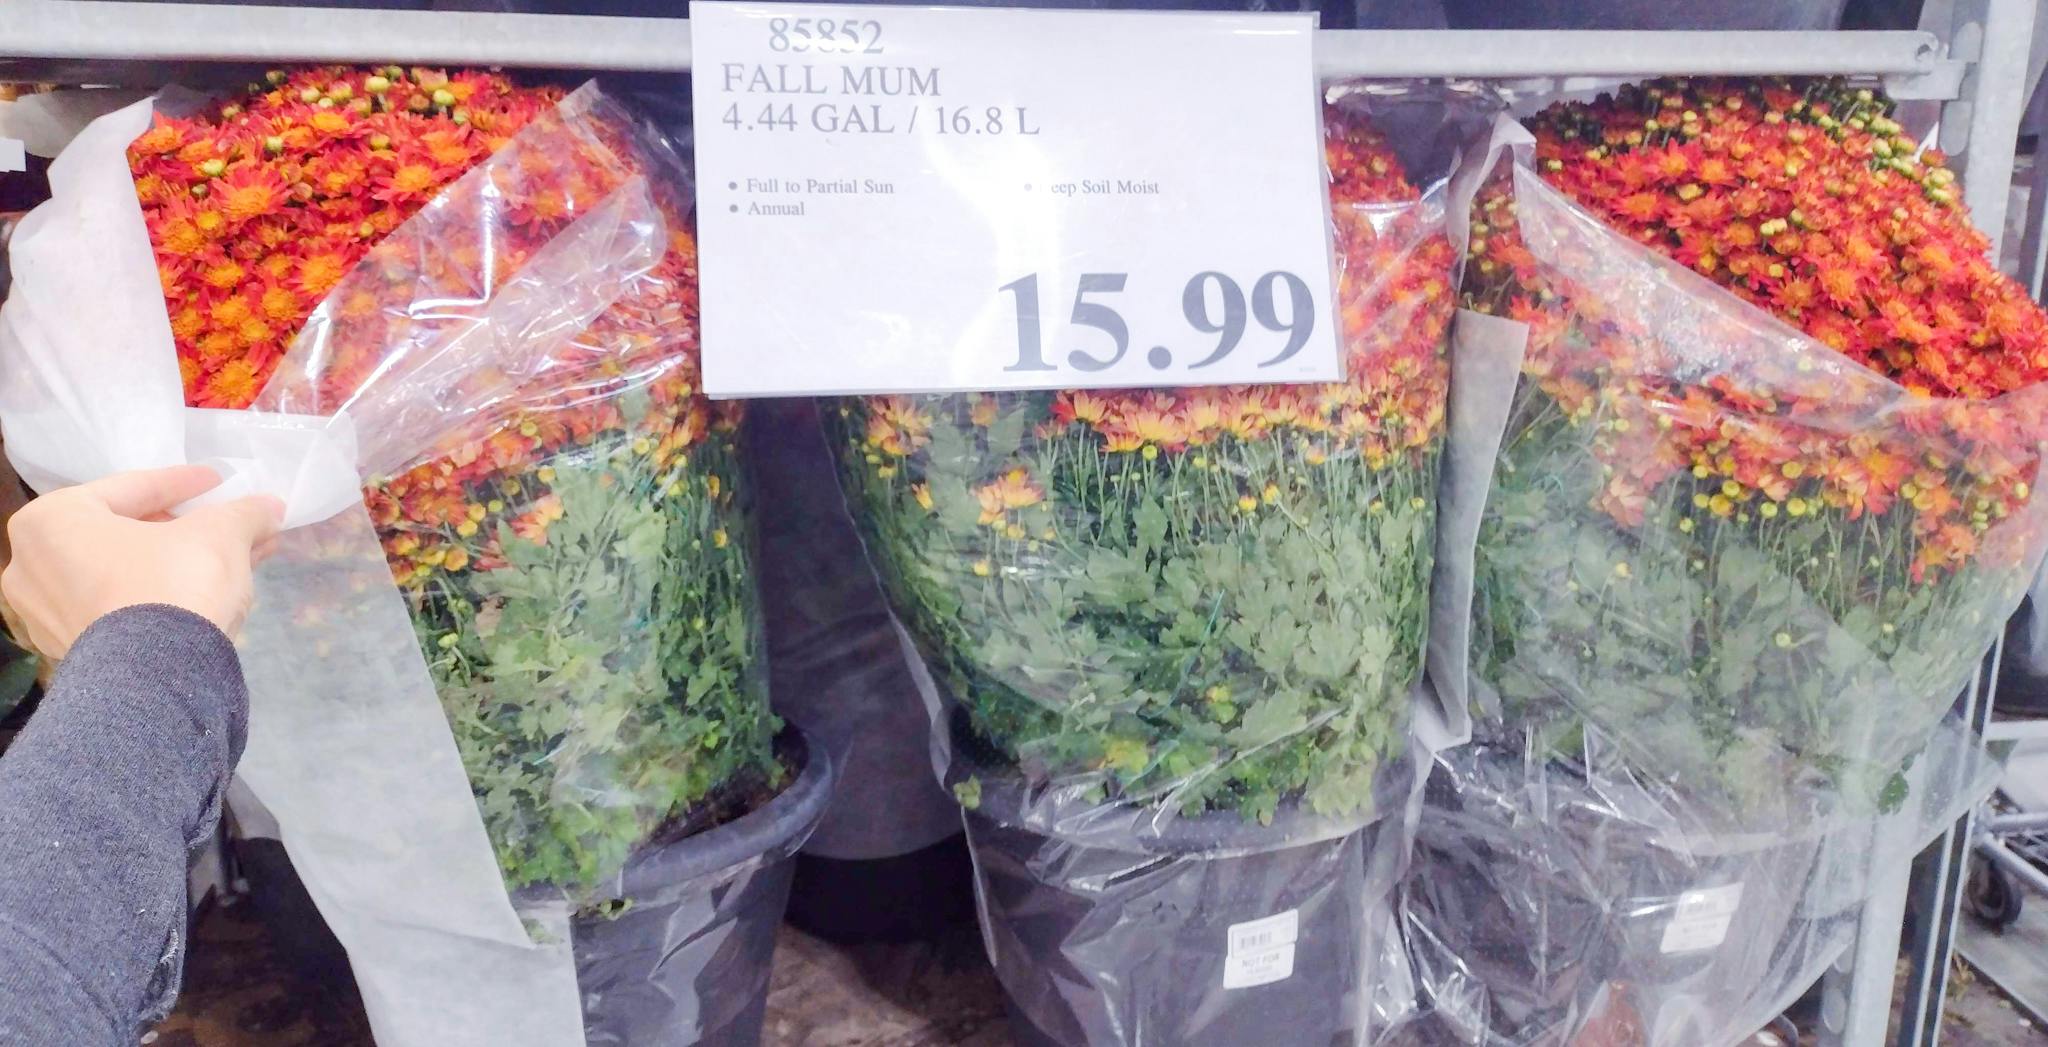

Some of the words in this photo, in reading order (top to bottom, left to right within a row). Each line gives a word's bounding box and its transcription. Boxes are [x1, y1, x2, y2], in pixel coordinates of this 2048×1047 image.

[768, 17, 885, 54] 85852
[721, 63, 828, 94] FALL
[840, 65, 942, 96] MUM
[722, 102, 798, 131] 4.44
[811, 104, 894, 133] GAL
[908, 105, 919, 134] /
[936, 106, 1003, 134] 16.8
[1017, 107, 1040, 135] L
[746, 178, 779, 193] Full
[785, 181, 801, 193] to
[806, 179, 858, 194] Partial
[864, 179, 894, 194] Sun
[1042, 180, 1077, 197] eep
[1082, 179, 1111, 194] Soil
[1117, 180, 1160, 194] Moist
[747, 201, 805, 216] Annual
[998, 270, 1316, 373] 15.99
[1242, 956, 1261, 968] NOT
